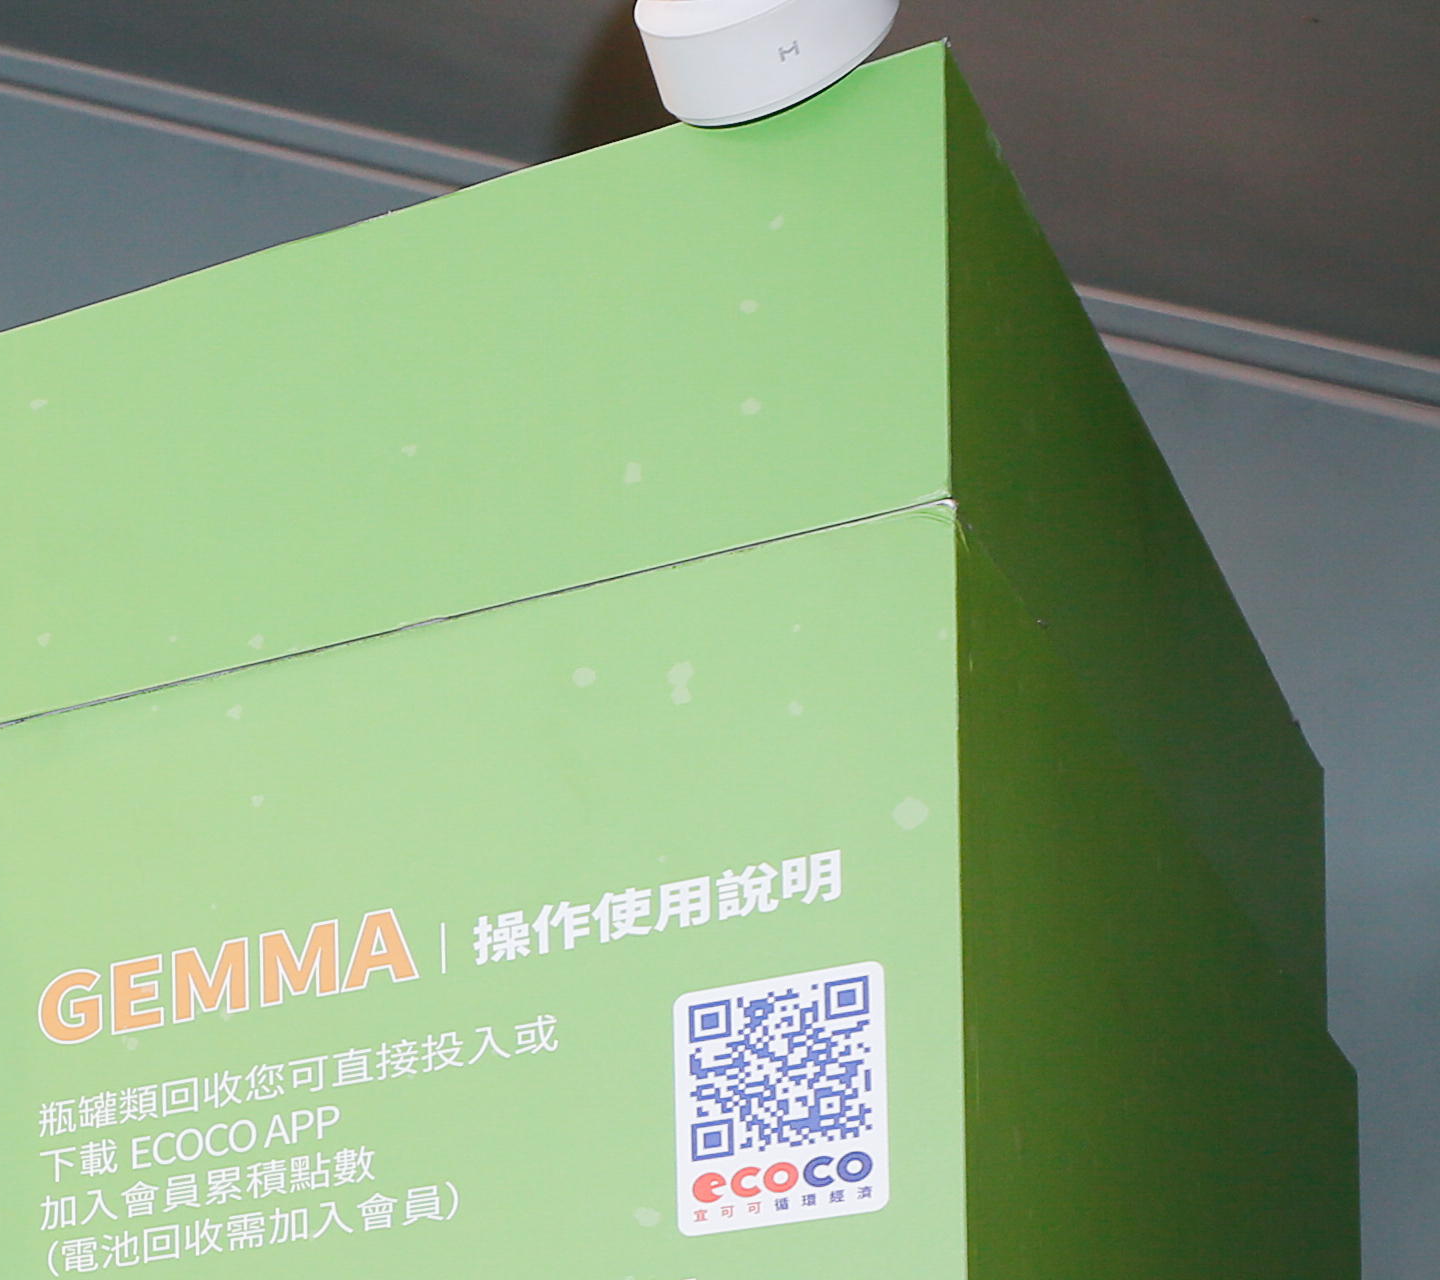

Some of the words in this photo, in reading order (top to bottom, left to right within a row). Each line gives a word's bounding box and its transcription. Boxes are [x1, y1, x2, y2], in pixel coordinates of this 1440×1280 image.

[38, 907, 420, 1045] GEMMA
[472, 848, 844, 967] 操作使用說明
[38, 1015, 559, 1139] 瓶罐類回收您可直接投入或
[40, 1138, 119, 1188] 下載
[130, 1119, 259, 1172] ECOCO
[263, 1104, 343, 1152] APP
[40, 1146, 376, 1233] 加入會員累積點數
[692, 1151, 873, 1204] ecoco
[46, 1180, 460, 1278] (電池回收需加入會員)
